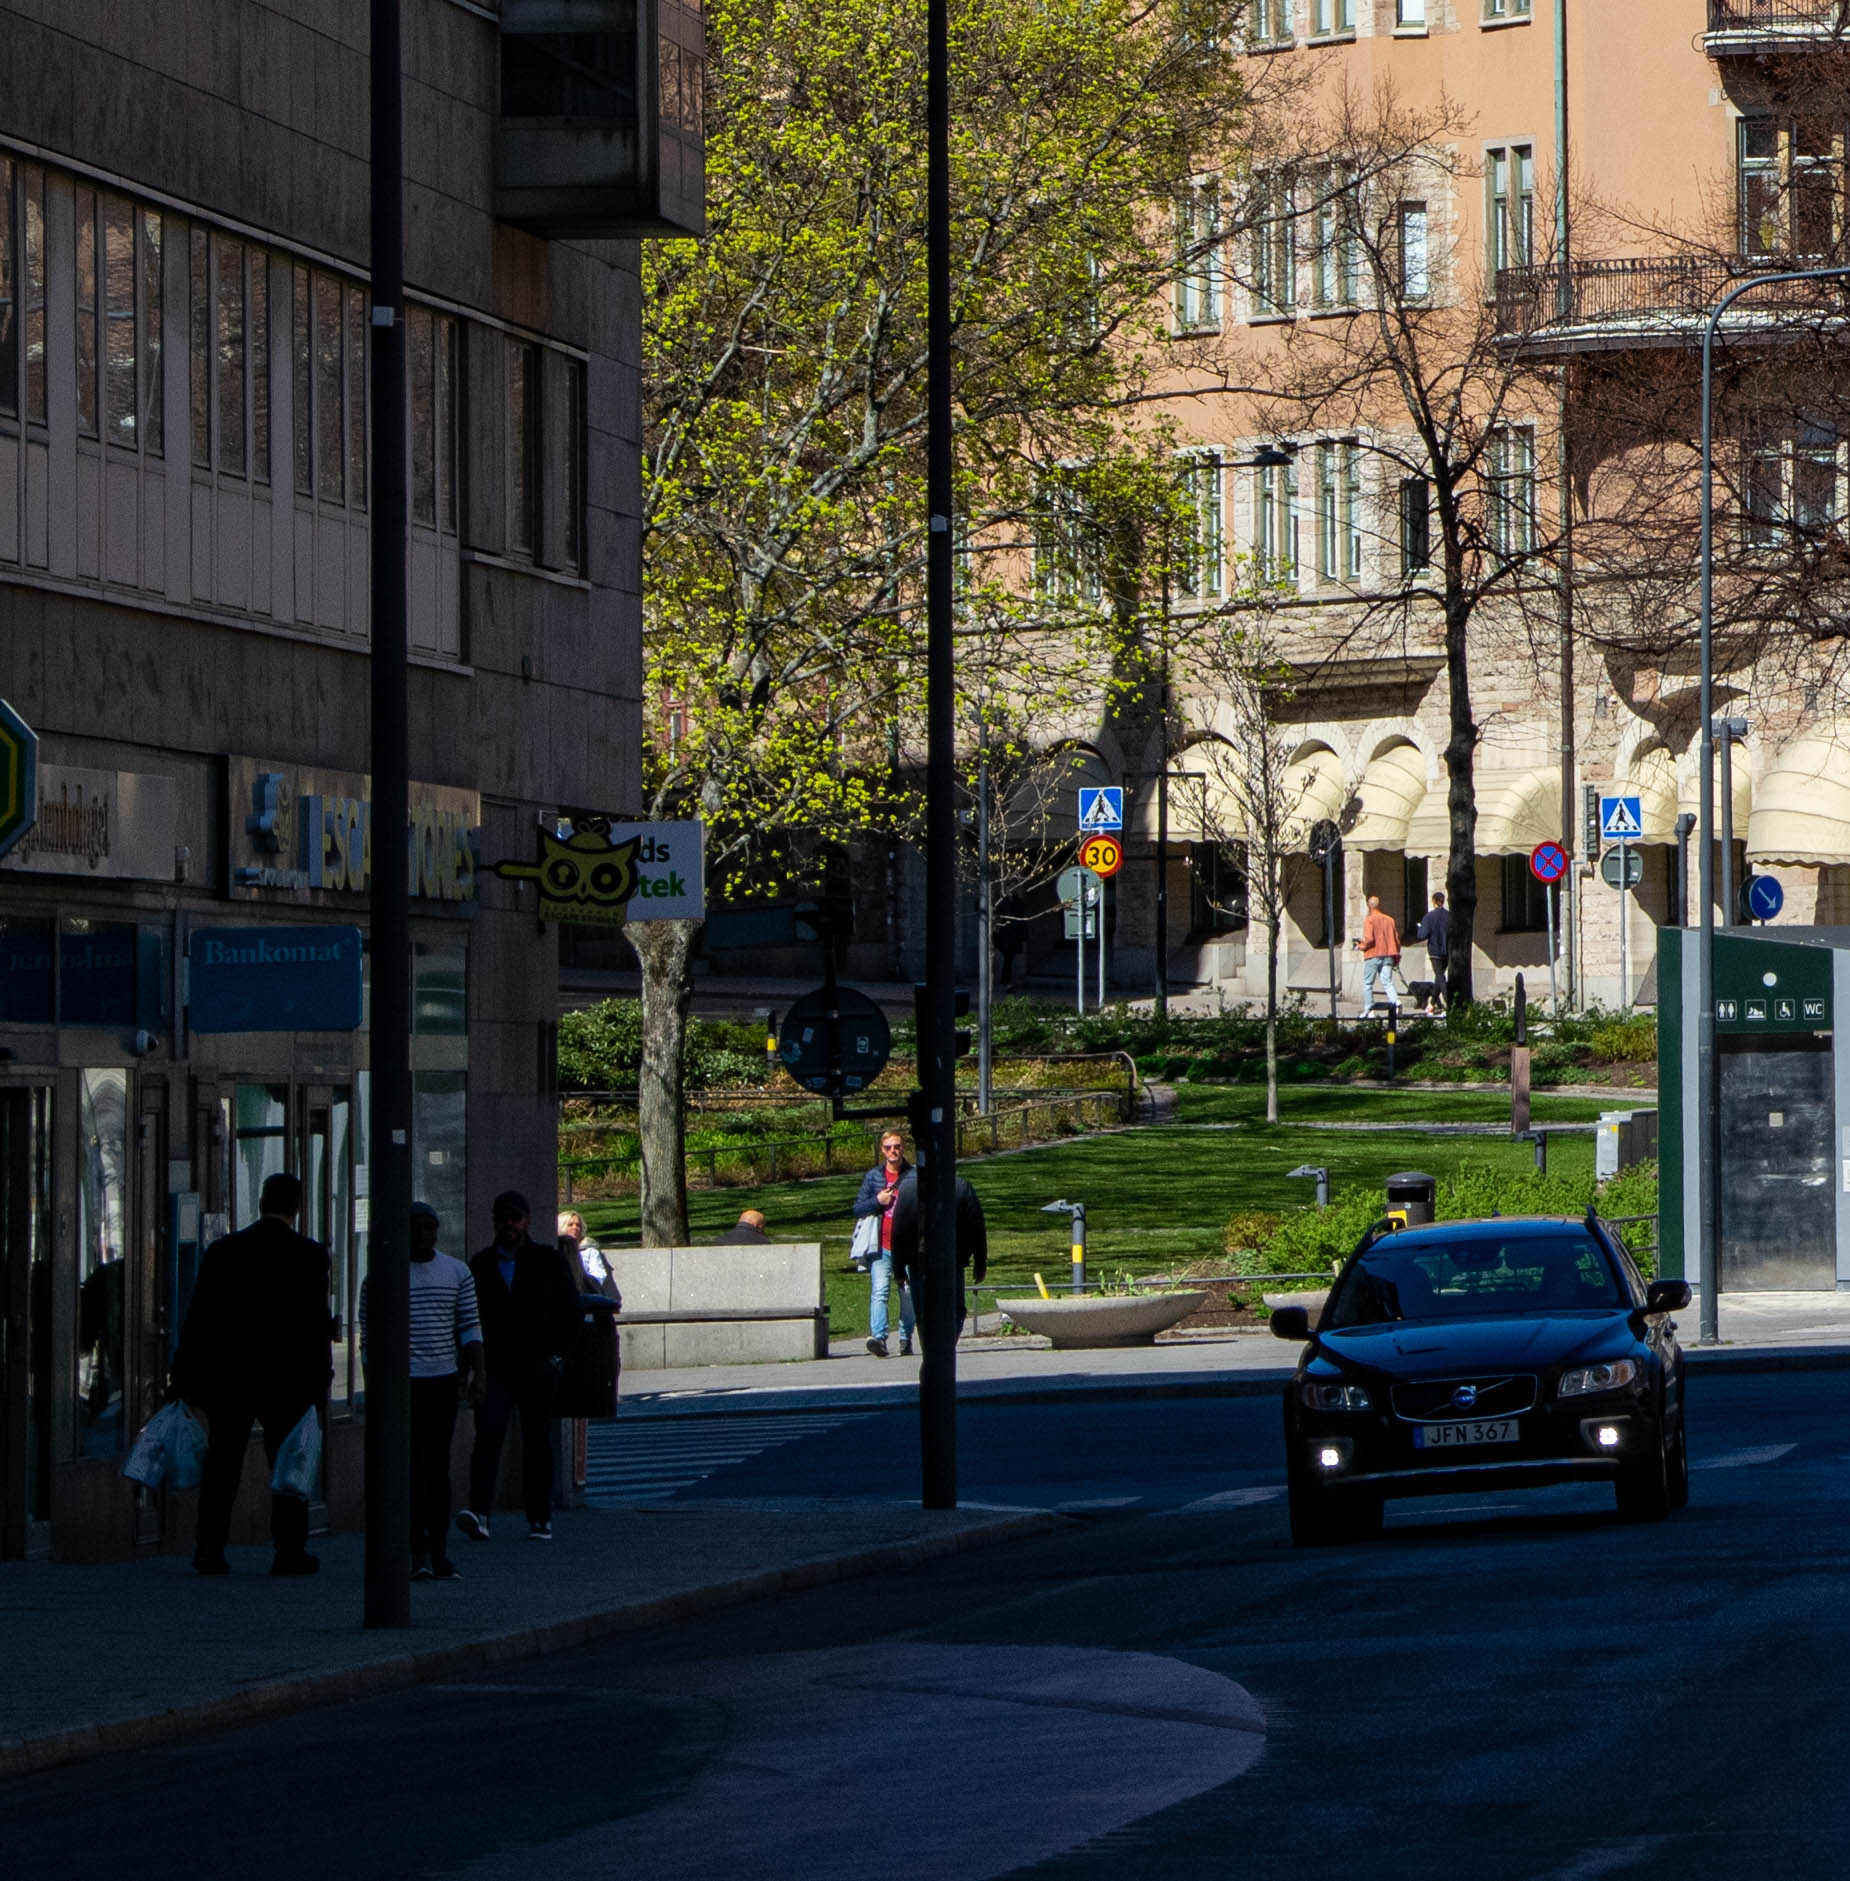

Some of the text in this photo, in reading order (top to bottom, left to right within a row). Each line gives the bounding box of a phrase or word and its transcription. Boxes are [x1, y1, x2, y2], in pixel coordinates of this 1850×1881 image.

[1088, 846, 1117, 866] 30
[204, 937, 343, 966] Bankomat
[1804, 1003, 1823, 1015] WC
[1431, 1422, 1510, 1444] JFN 367
